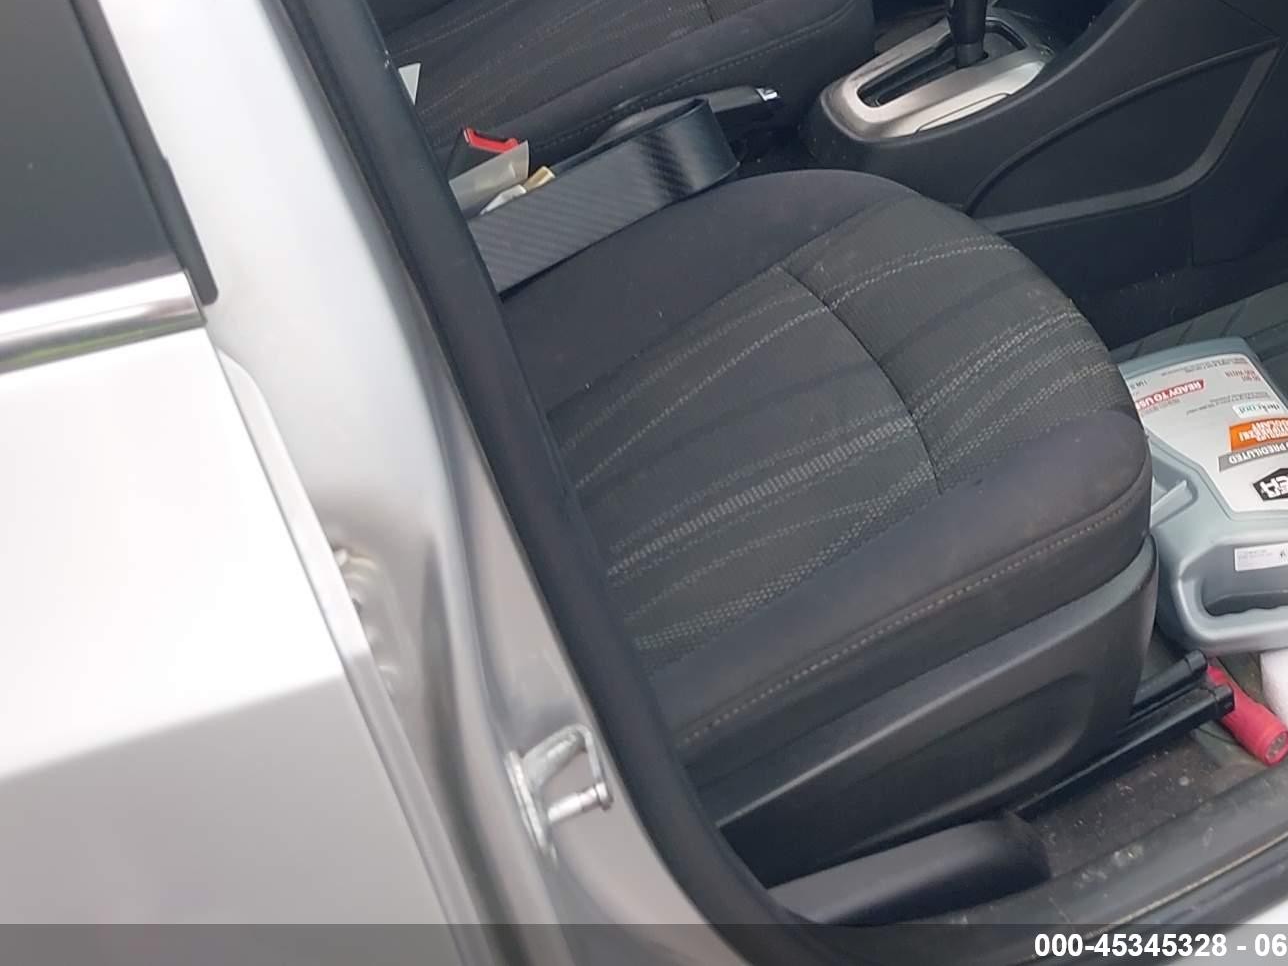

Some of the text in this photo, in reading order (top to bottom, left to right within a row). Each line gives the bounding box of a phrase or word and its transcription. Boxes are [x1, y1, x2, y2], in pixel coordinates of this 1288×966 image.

[1152, 391, 1168, 403] TO
[1168, 381, 1202, 399] READY
[1228, 442, 1286, 464] PREDILUTED
